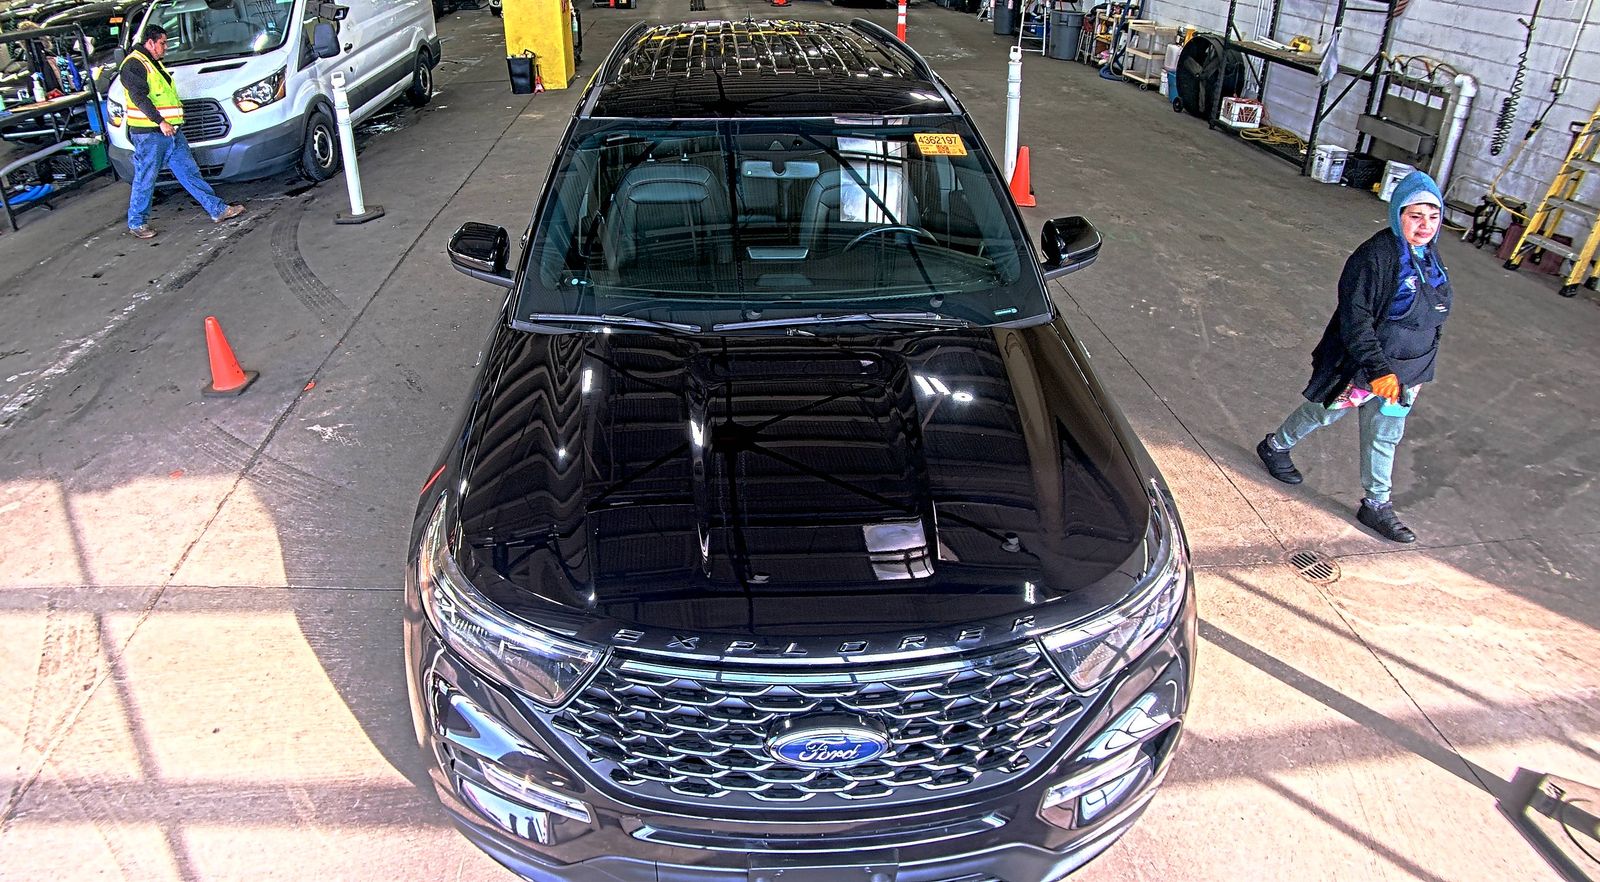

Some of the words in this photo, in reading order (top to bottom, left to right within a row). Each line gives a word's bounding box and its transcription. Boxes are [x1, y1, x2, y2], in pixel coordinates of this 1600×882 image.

[918, 136, 957, 145] 4362197
[612, 615, 1036, 655] EXPLORER
[798, 738, 862, 761] Ford
